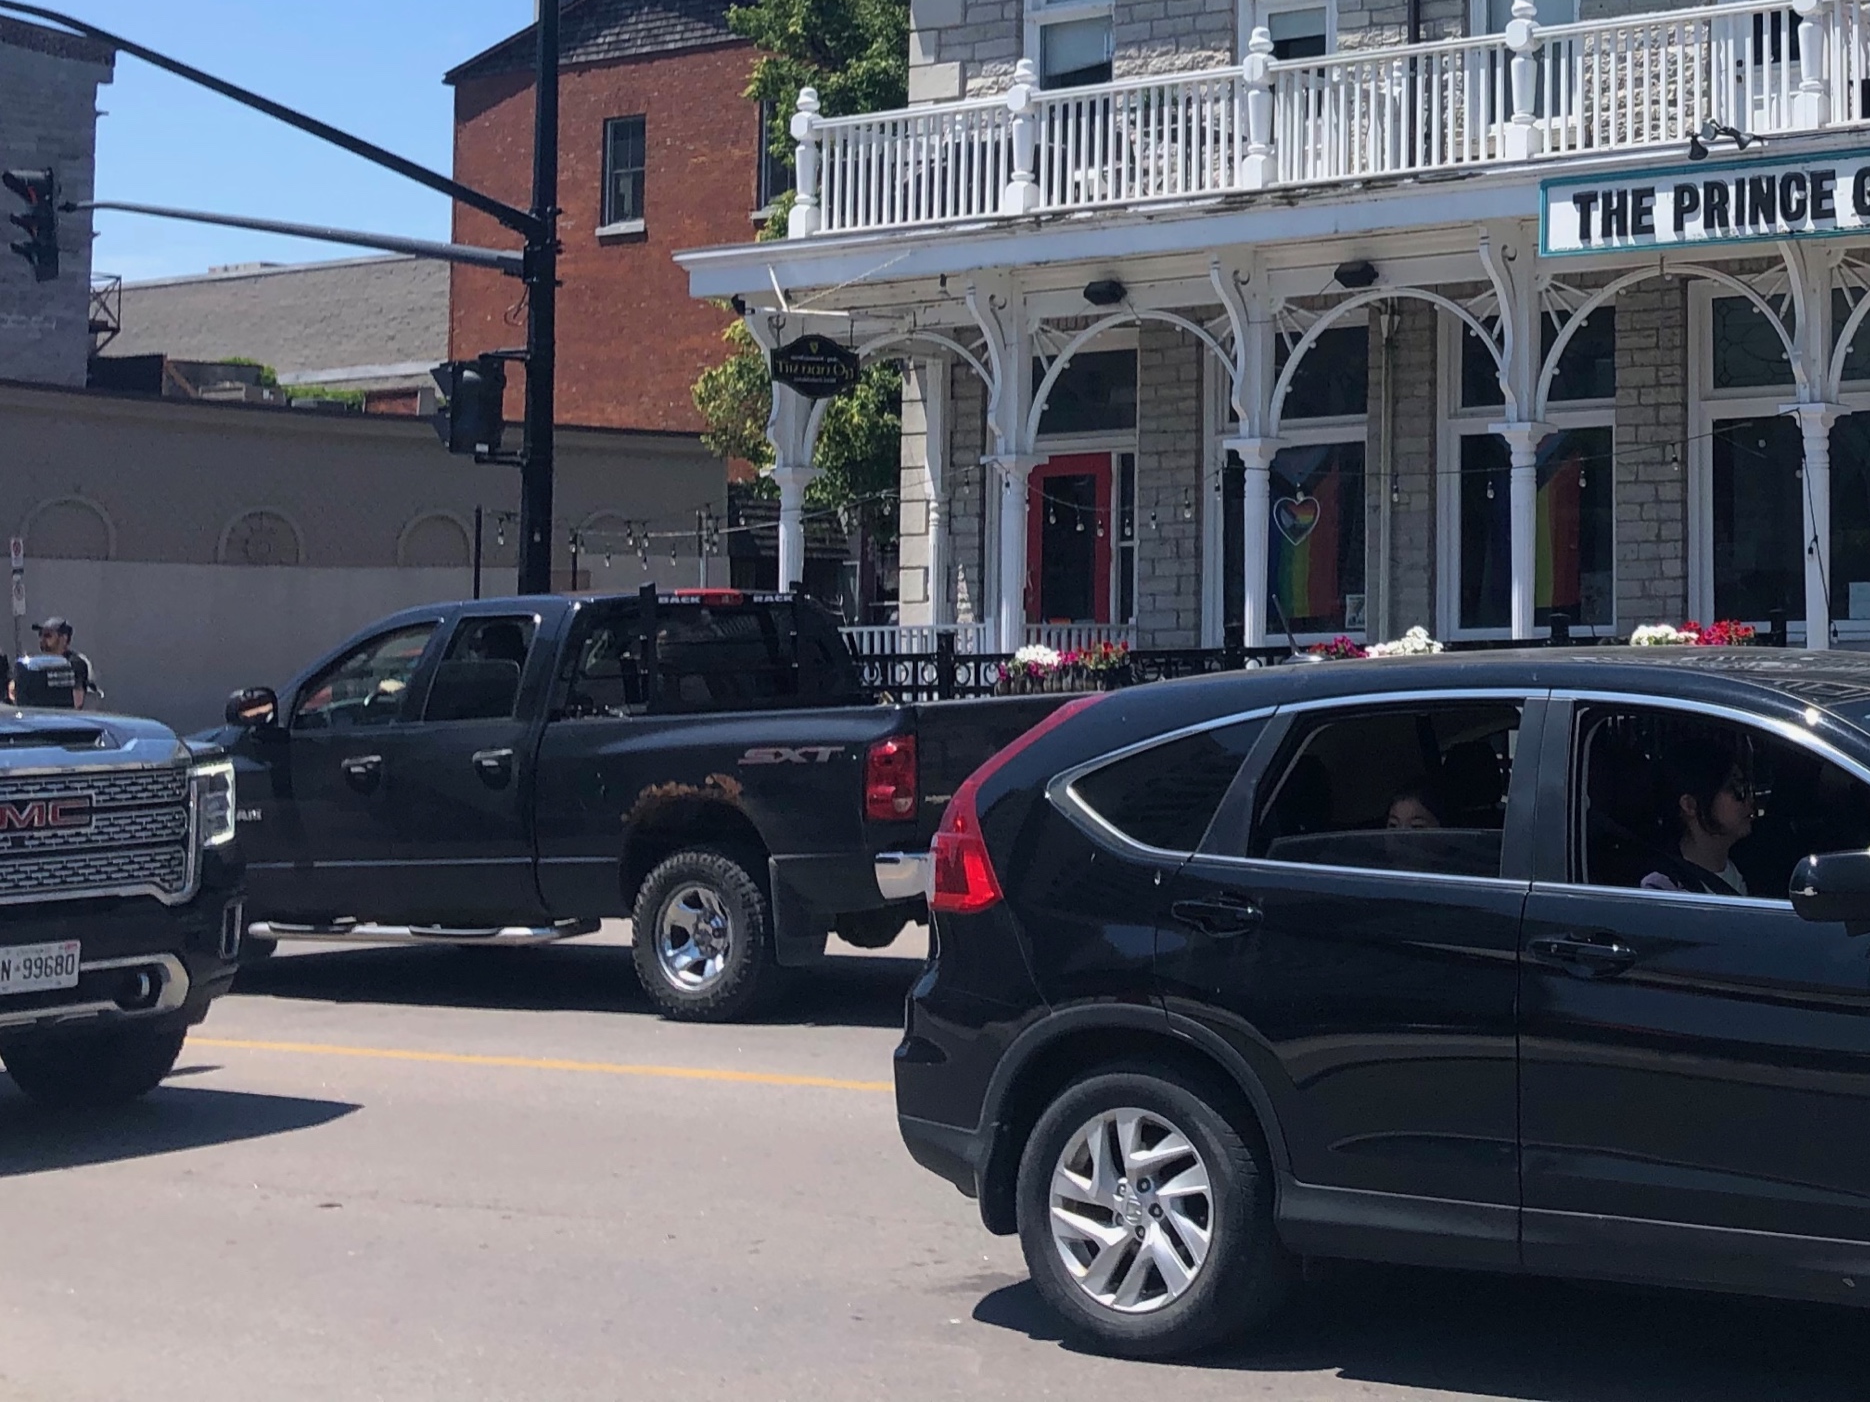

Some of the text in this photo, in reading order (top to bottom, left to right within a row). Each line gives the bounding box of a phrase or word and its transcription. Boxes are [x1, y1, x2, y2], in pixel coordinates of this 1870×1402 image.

[1573, 186, 1655, 240] THE
[1674, 169, 1836, 232] PRINCE
[738, 745, 845, 765] SXT
[0, 800, 91, 830] MC
[22, 953, 75, 979] 99680
